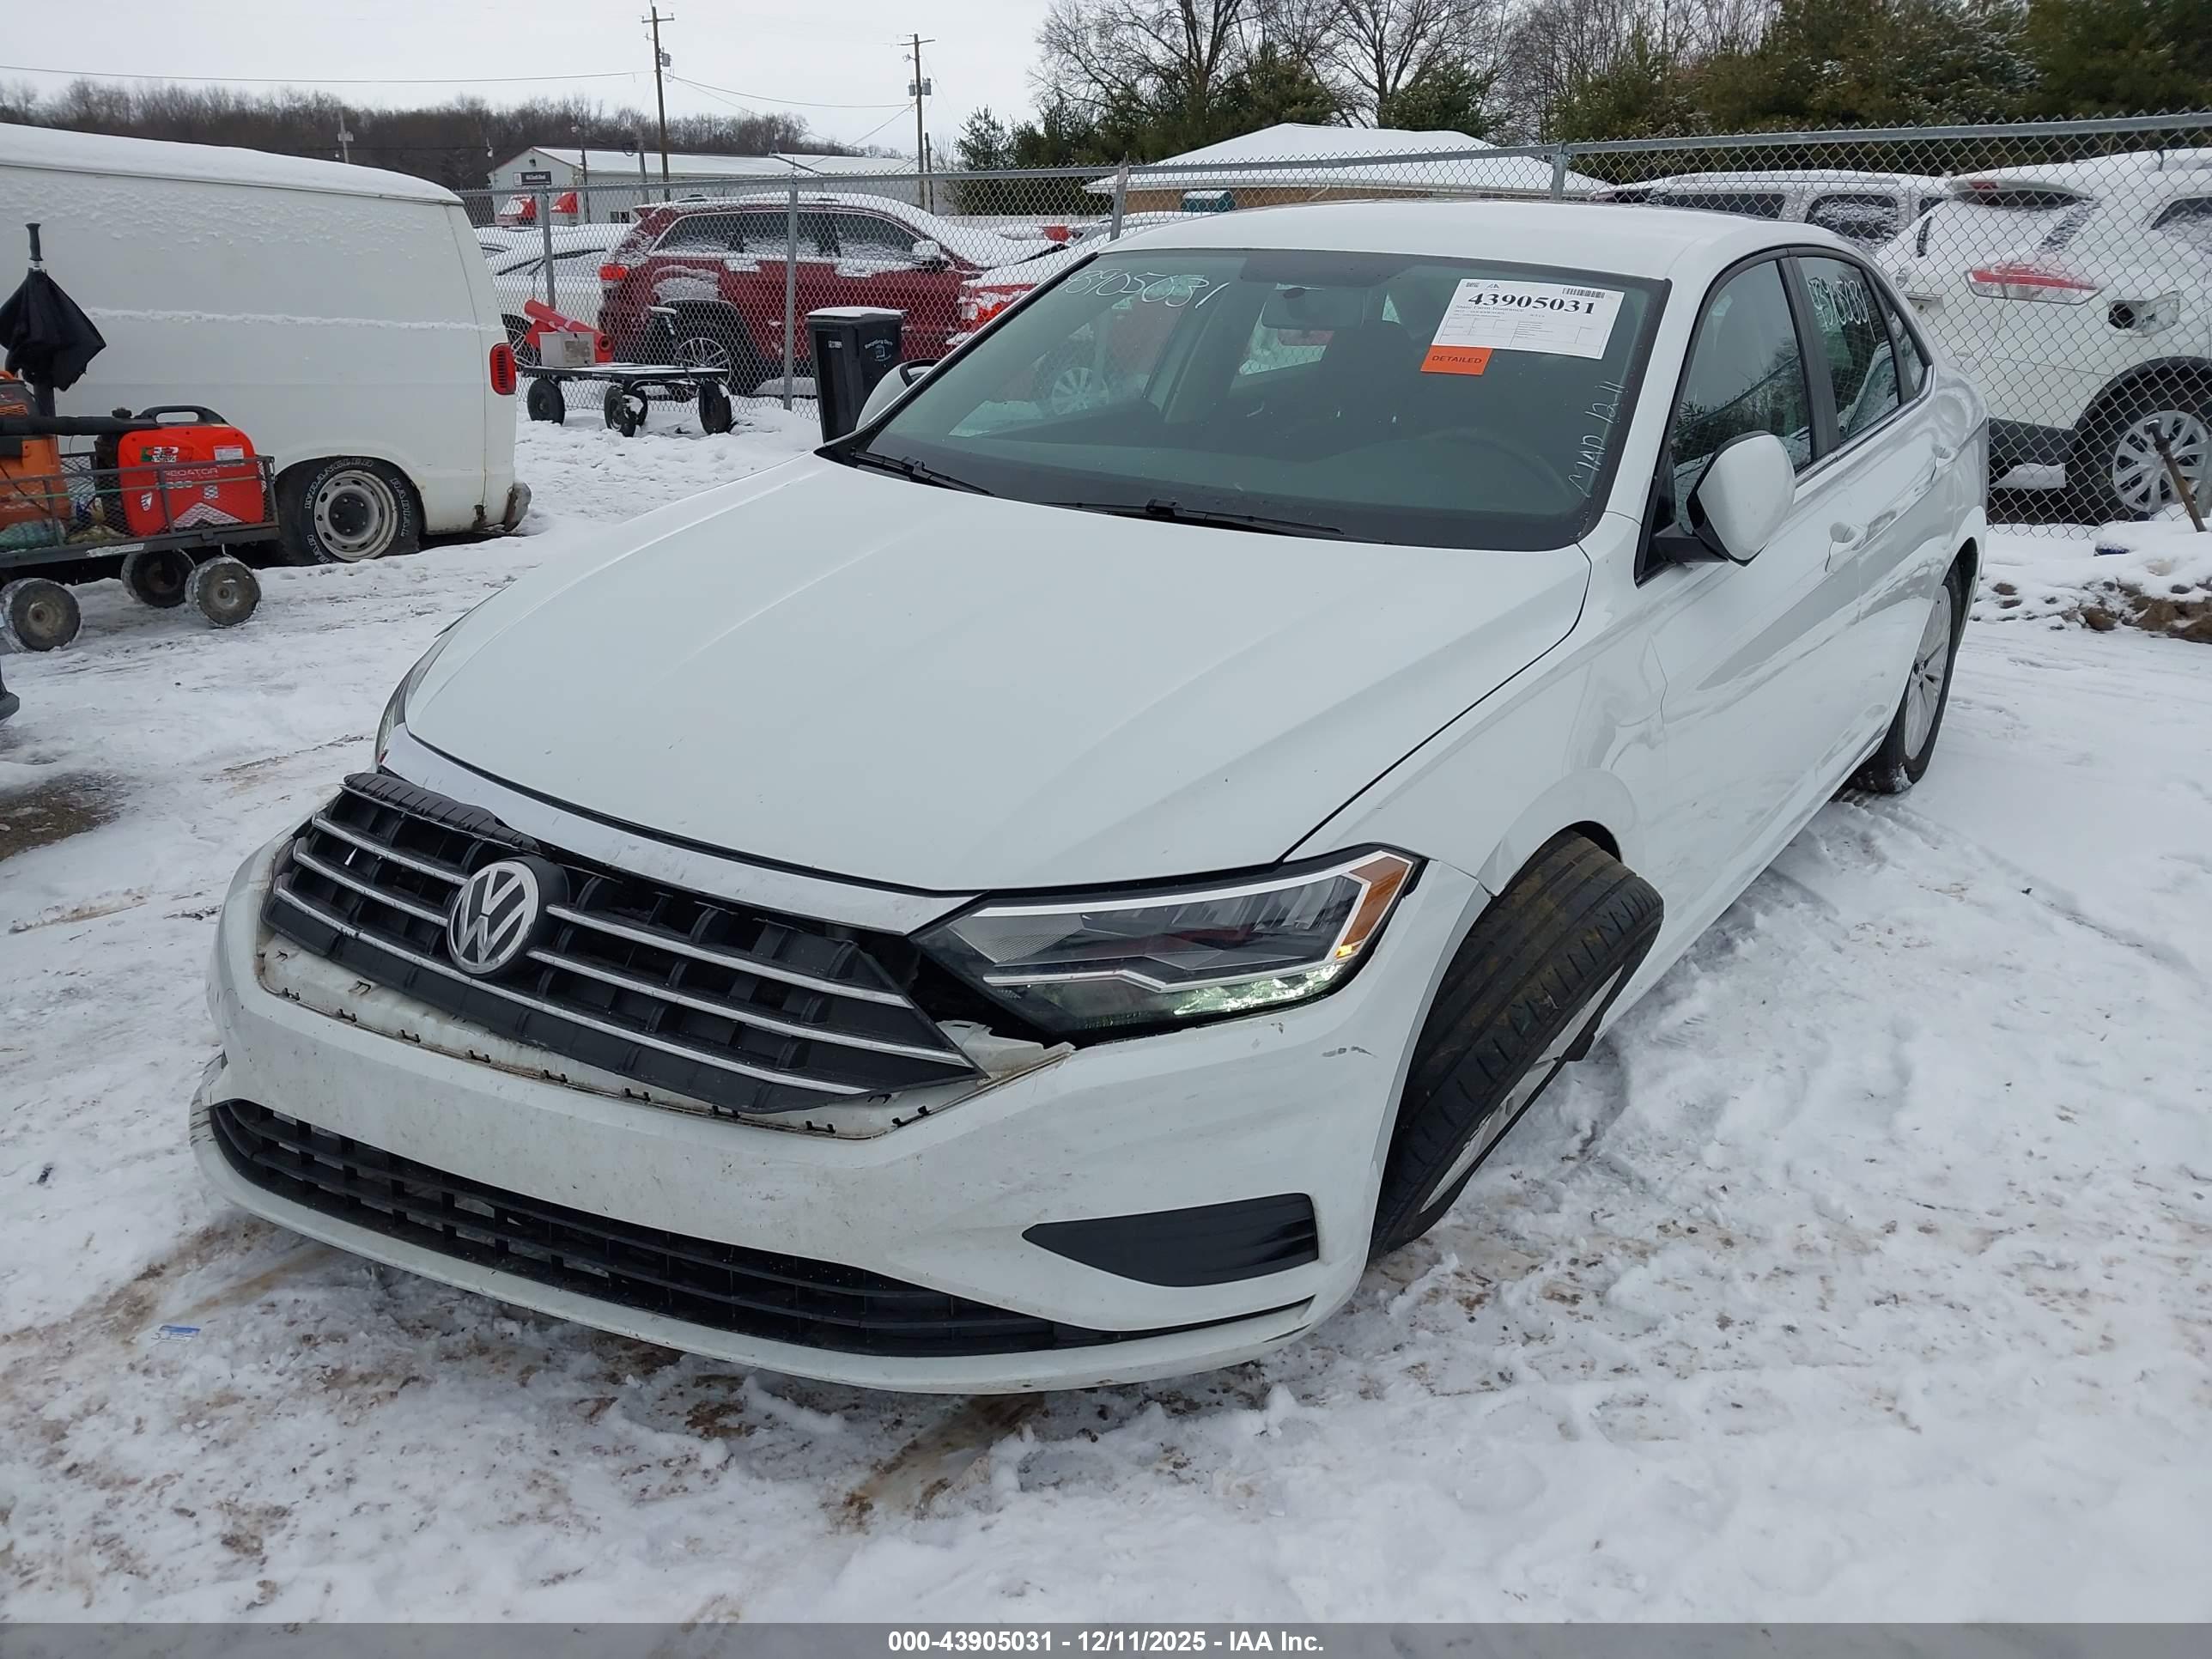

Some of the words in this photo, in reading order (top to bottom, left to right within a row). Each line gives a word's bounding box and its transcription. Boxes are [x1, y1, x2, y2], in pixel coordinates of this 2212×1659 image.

[1468, 292, 1595, 315] 43905031
[1431, 355, 1482, 365] DETAILED
[389, 477, 411, 538] RADIAL
